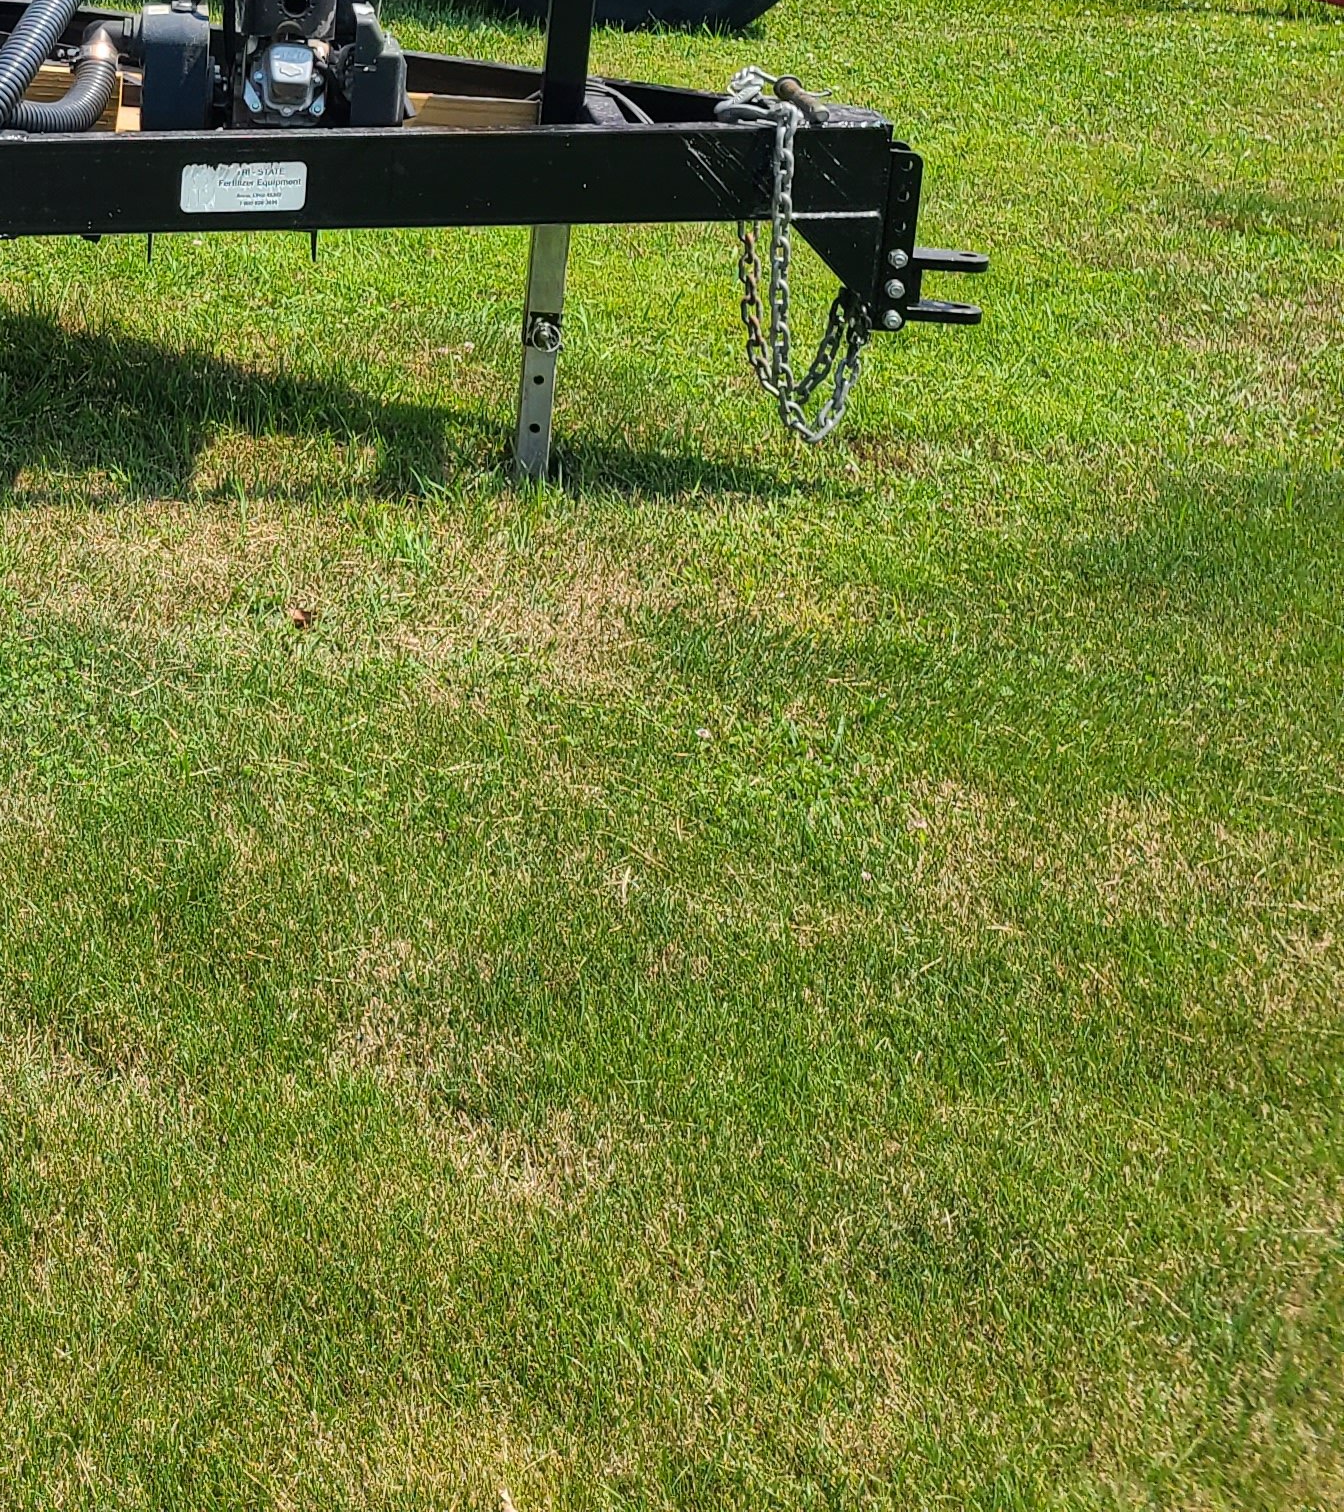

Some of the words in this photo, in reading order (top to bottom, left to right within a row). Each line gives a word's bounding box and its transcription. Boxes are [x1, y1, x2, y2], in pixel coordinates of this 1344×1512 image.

[258, 167, 286, 175] STATE
[219, 179, 254, 187] Fertilizer
[257, 178, 302, 188] Equipment
